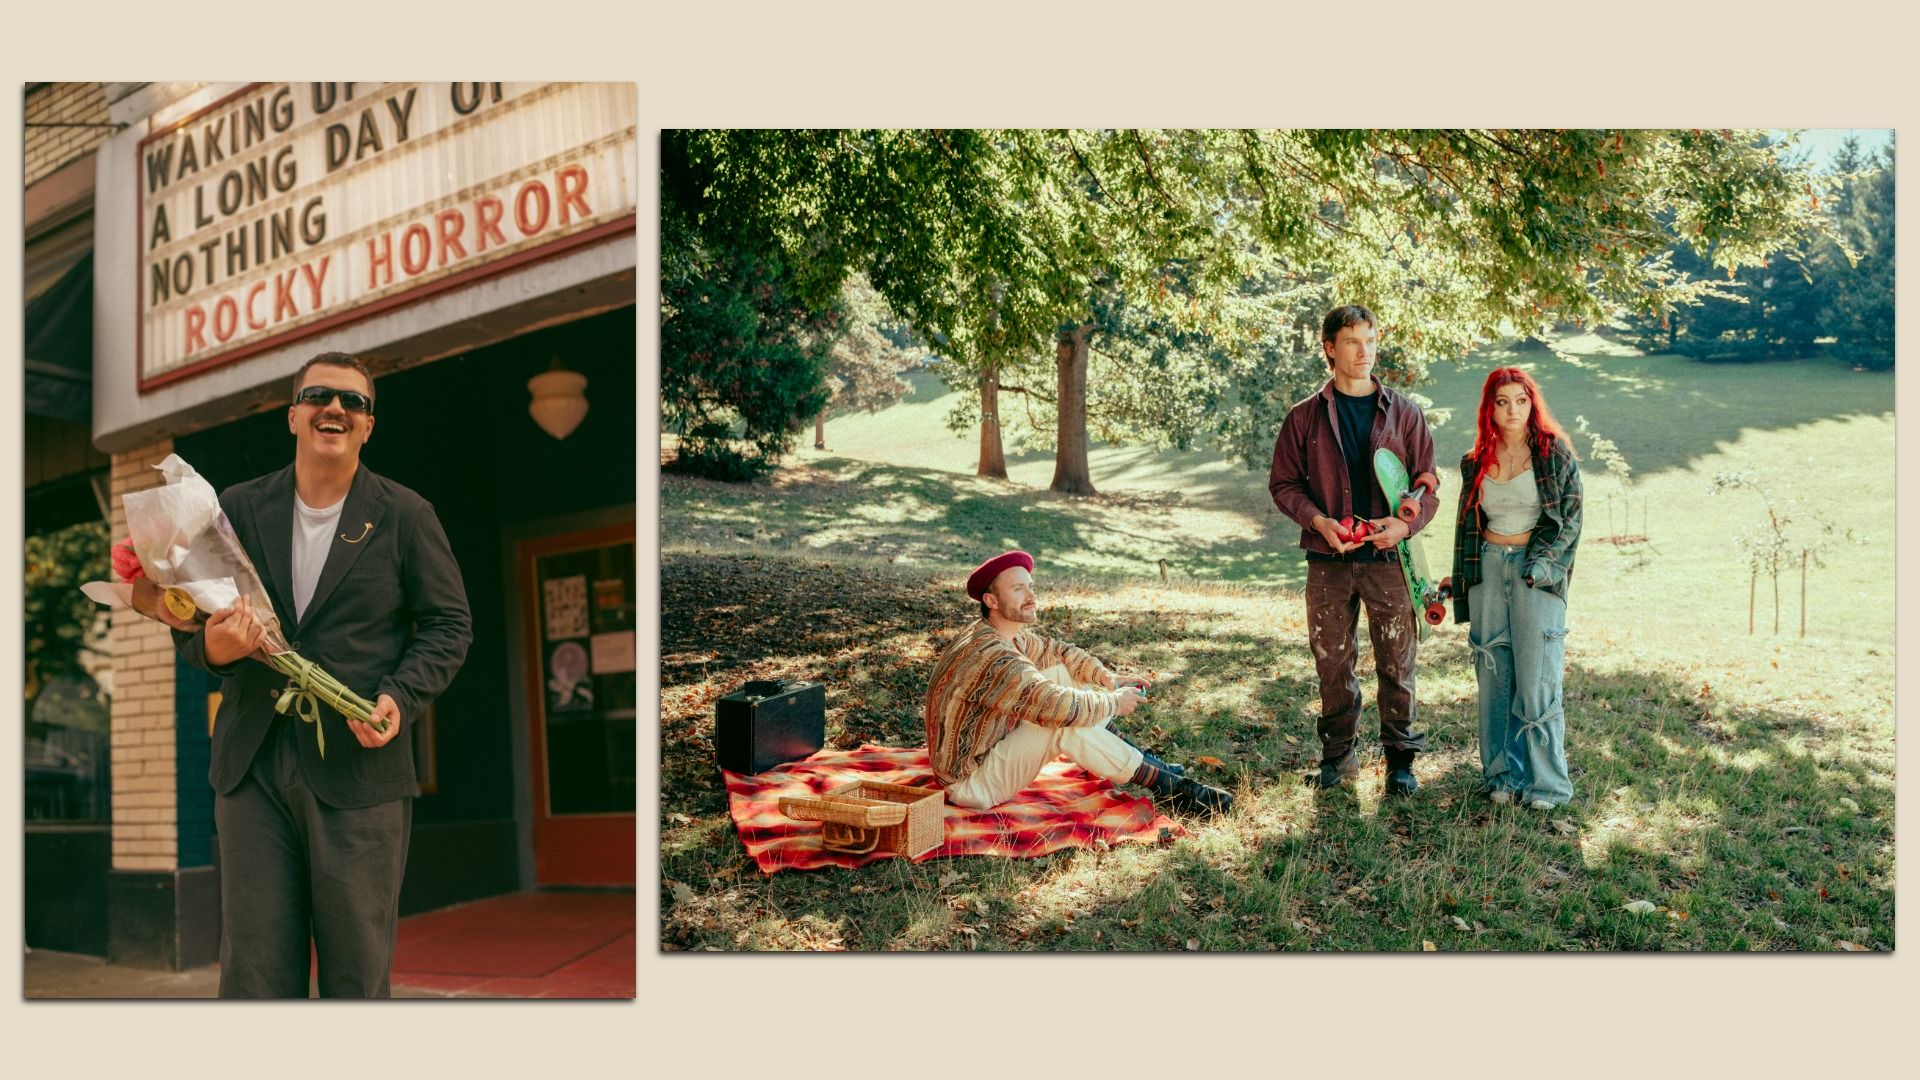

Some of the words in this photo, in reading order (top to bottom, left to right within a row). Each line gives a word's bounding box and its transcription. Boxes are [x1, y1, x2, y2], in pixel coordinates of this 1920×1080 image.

[146, 85, 294, 195] WAKING
[150, 202, 171, 250] A
[195, 144, 297, 229] LONG
[325, 87, 418, 174] DAY
[151, 200, 327, 307] NOTHING
[184, 255, 330, 355] ROCKY
[366, 164, 592, 289] HORROR
